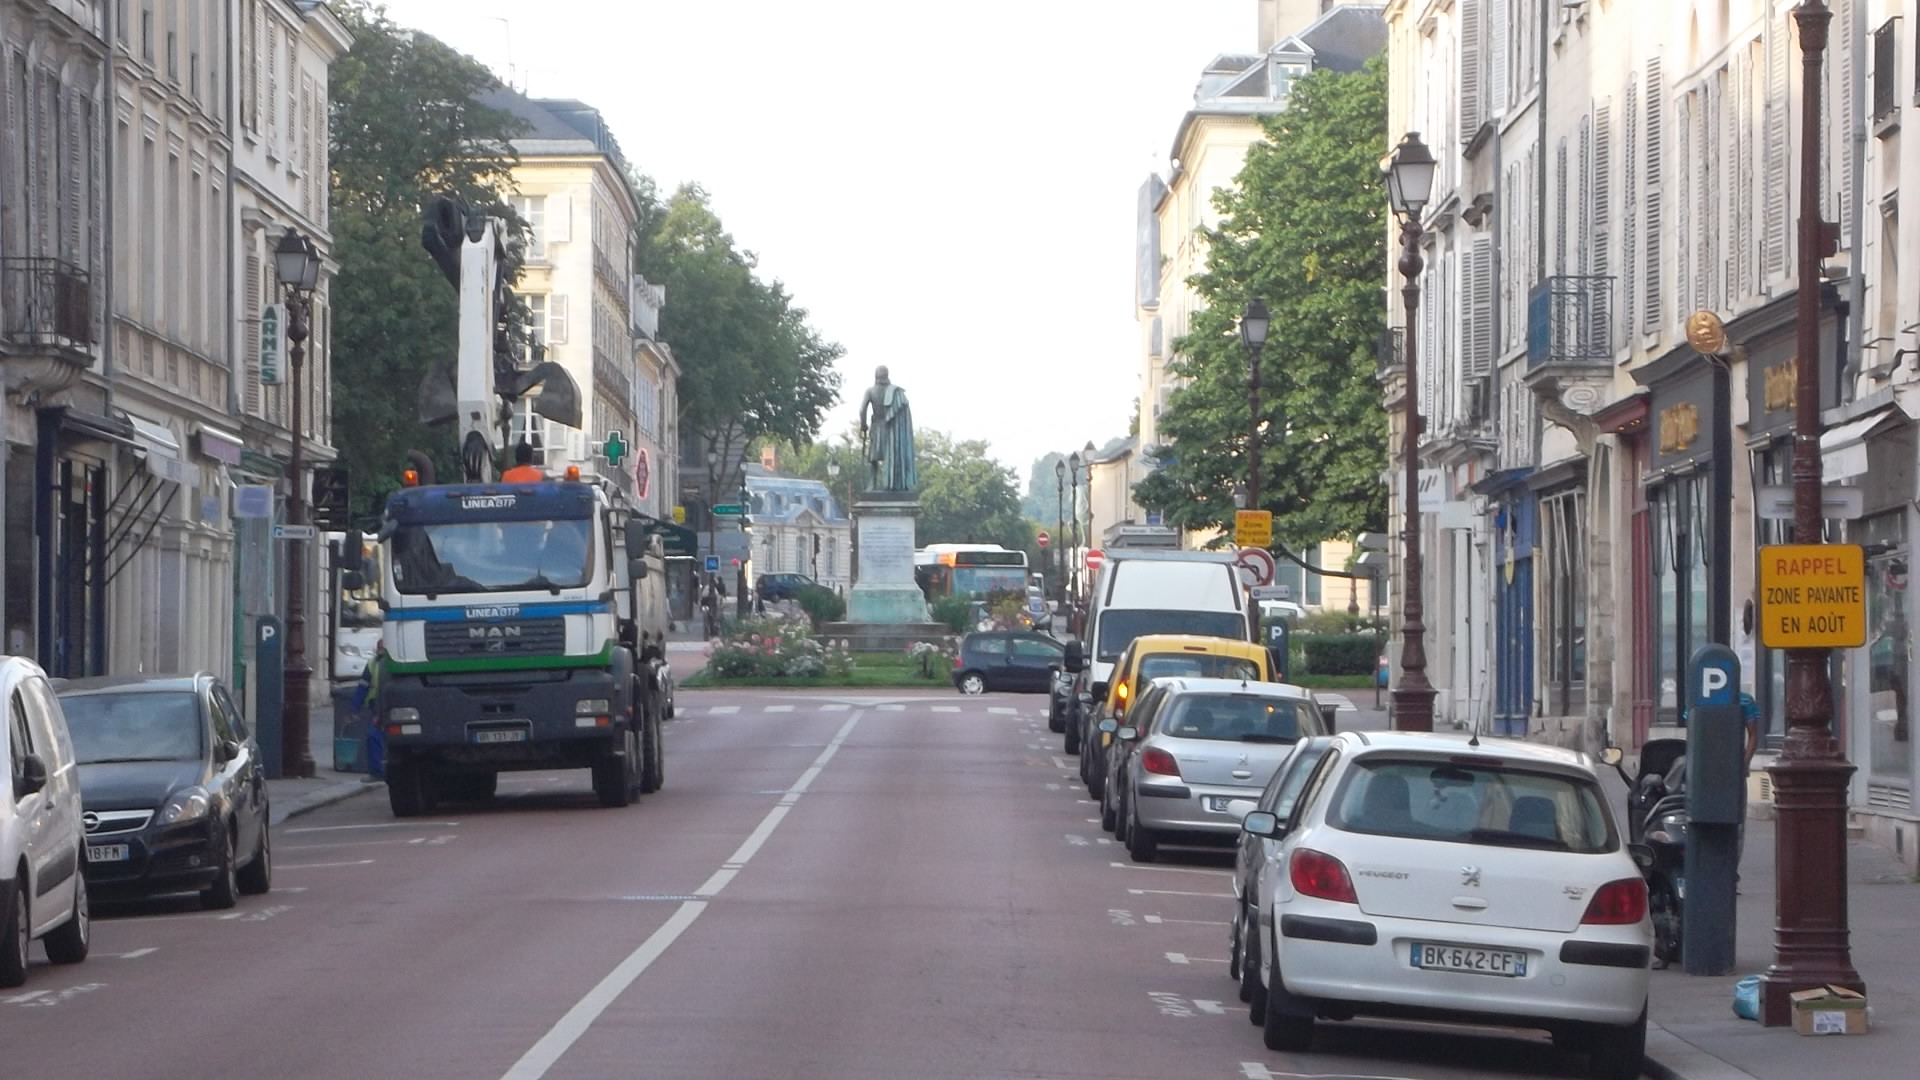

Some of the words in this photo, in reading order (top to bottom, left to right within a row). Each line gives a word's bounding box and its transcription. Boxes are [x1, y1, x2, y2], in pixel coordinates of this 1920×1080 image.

[262, 306, 277, 382] ARMES
[1776, 558, 1847, 576] RAPPEL
[1767, 587, 1801, 605] ZONE
[1807, 586, 1860, 604] PAYANTE
[469, 626, 521, 638] MAN
[1781, 617, 1800, 634] EN
[1808, 612, 1846, 634] AOÛT
[262, 625, 275, 641] P
[1271, 626, 1283, 640] P
[1702, 667, 1728, 698] P
[1358, 870, 1410, 880] PEUGEOT
